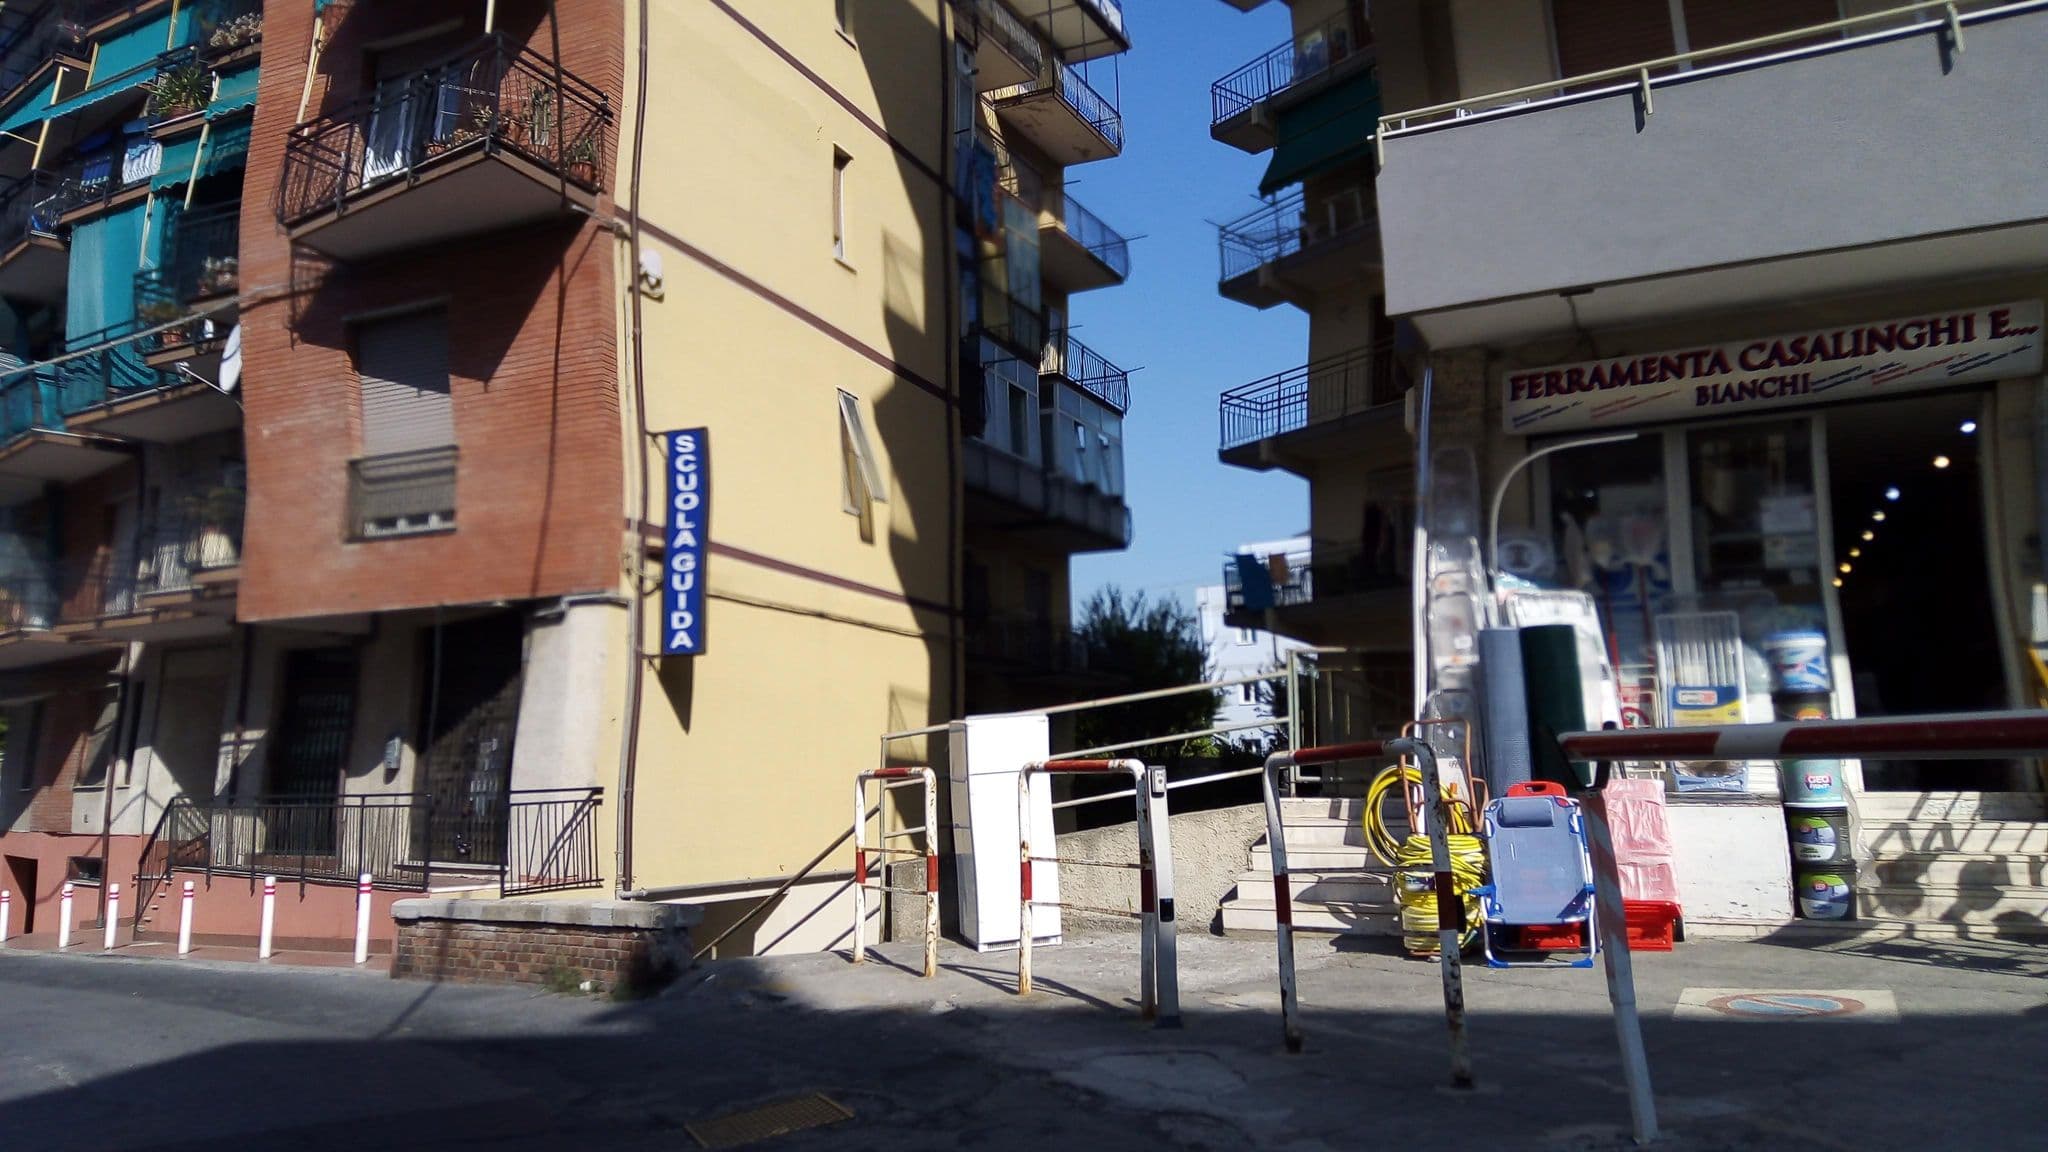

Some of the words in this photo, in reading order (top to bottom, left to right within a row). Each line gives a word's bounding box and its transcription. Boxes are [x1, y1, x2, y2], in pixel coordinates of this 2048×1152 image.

[1509, 346, 1733, 401] FERRAMENTA
[1740, 312, 1976, 372] CASALINGHI
[1695, 373, 1811, 406] BIANCHI
[674, 435, 699, 548] SCUOLA
[671, 552, 696, 648] GUIDA
